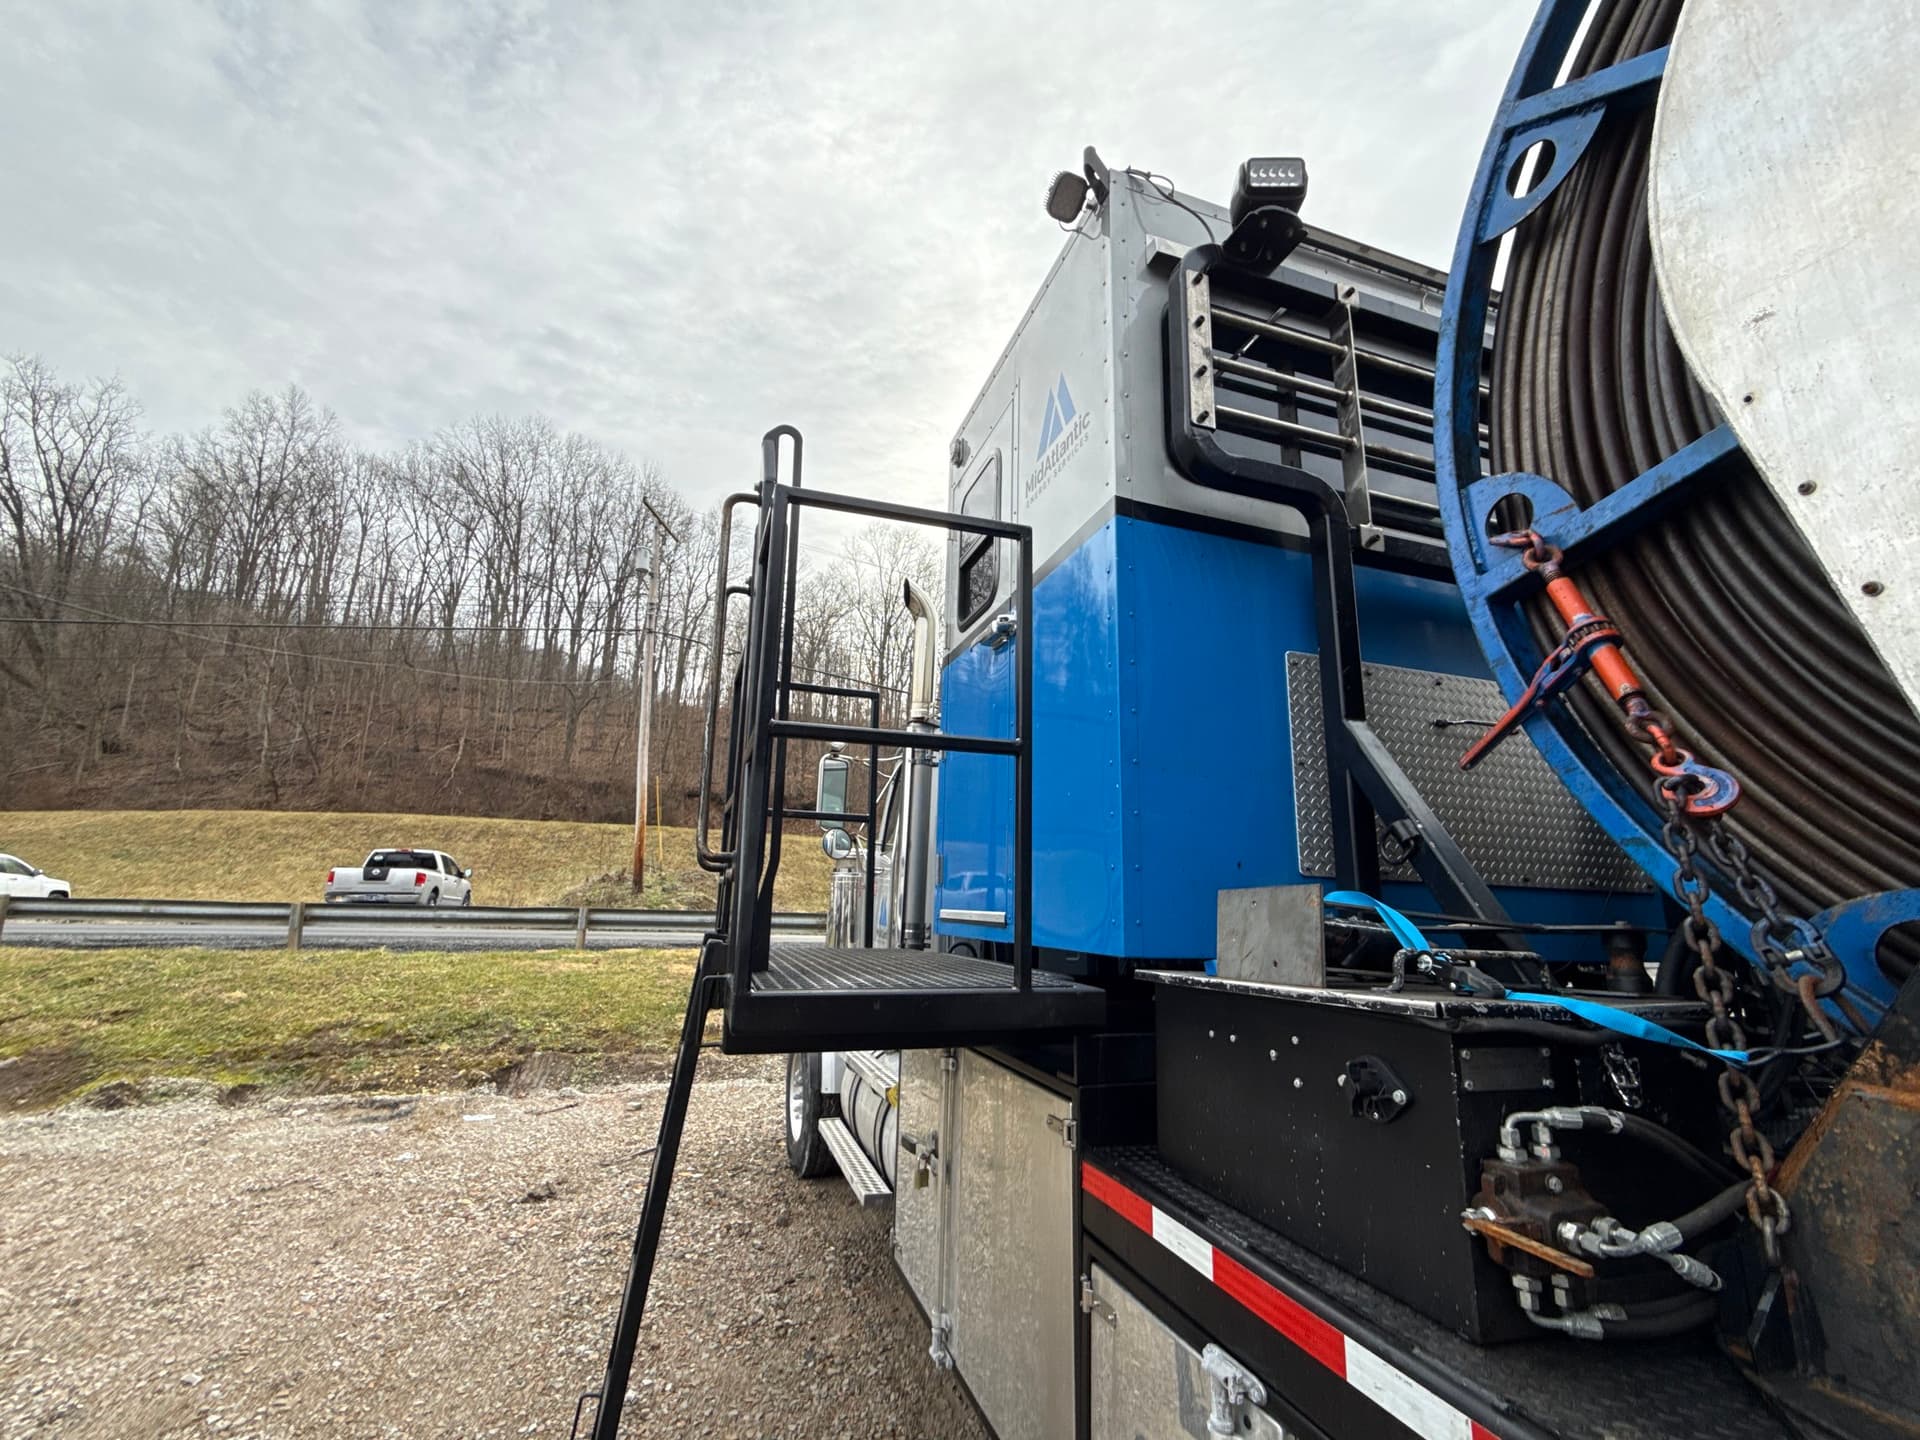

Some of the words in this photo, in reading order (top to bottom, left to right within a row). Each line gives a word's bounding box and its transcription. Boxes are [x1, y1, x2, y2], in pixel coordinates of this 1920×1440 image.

[1026, 412, 1091, 498] MidAtlantic
[1026, 478, 1051, 508] ENERGY
[1053, 432, 1089, 478] SERVICES
